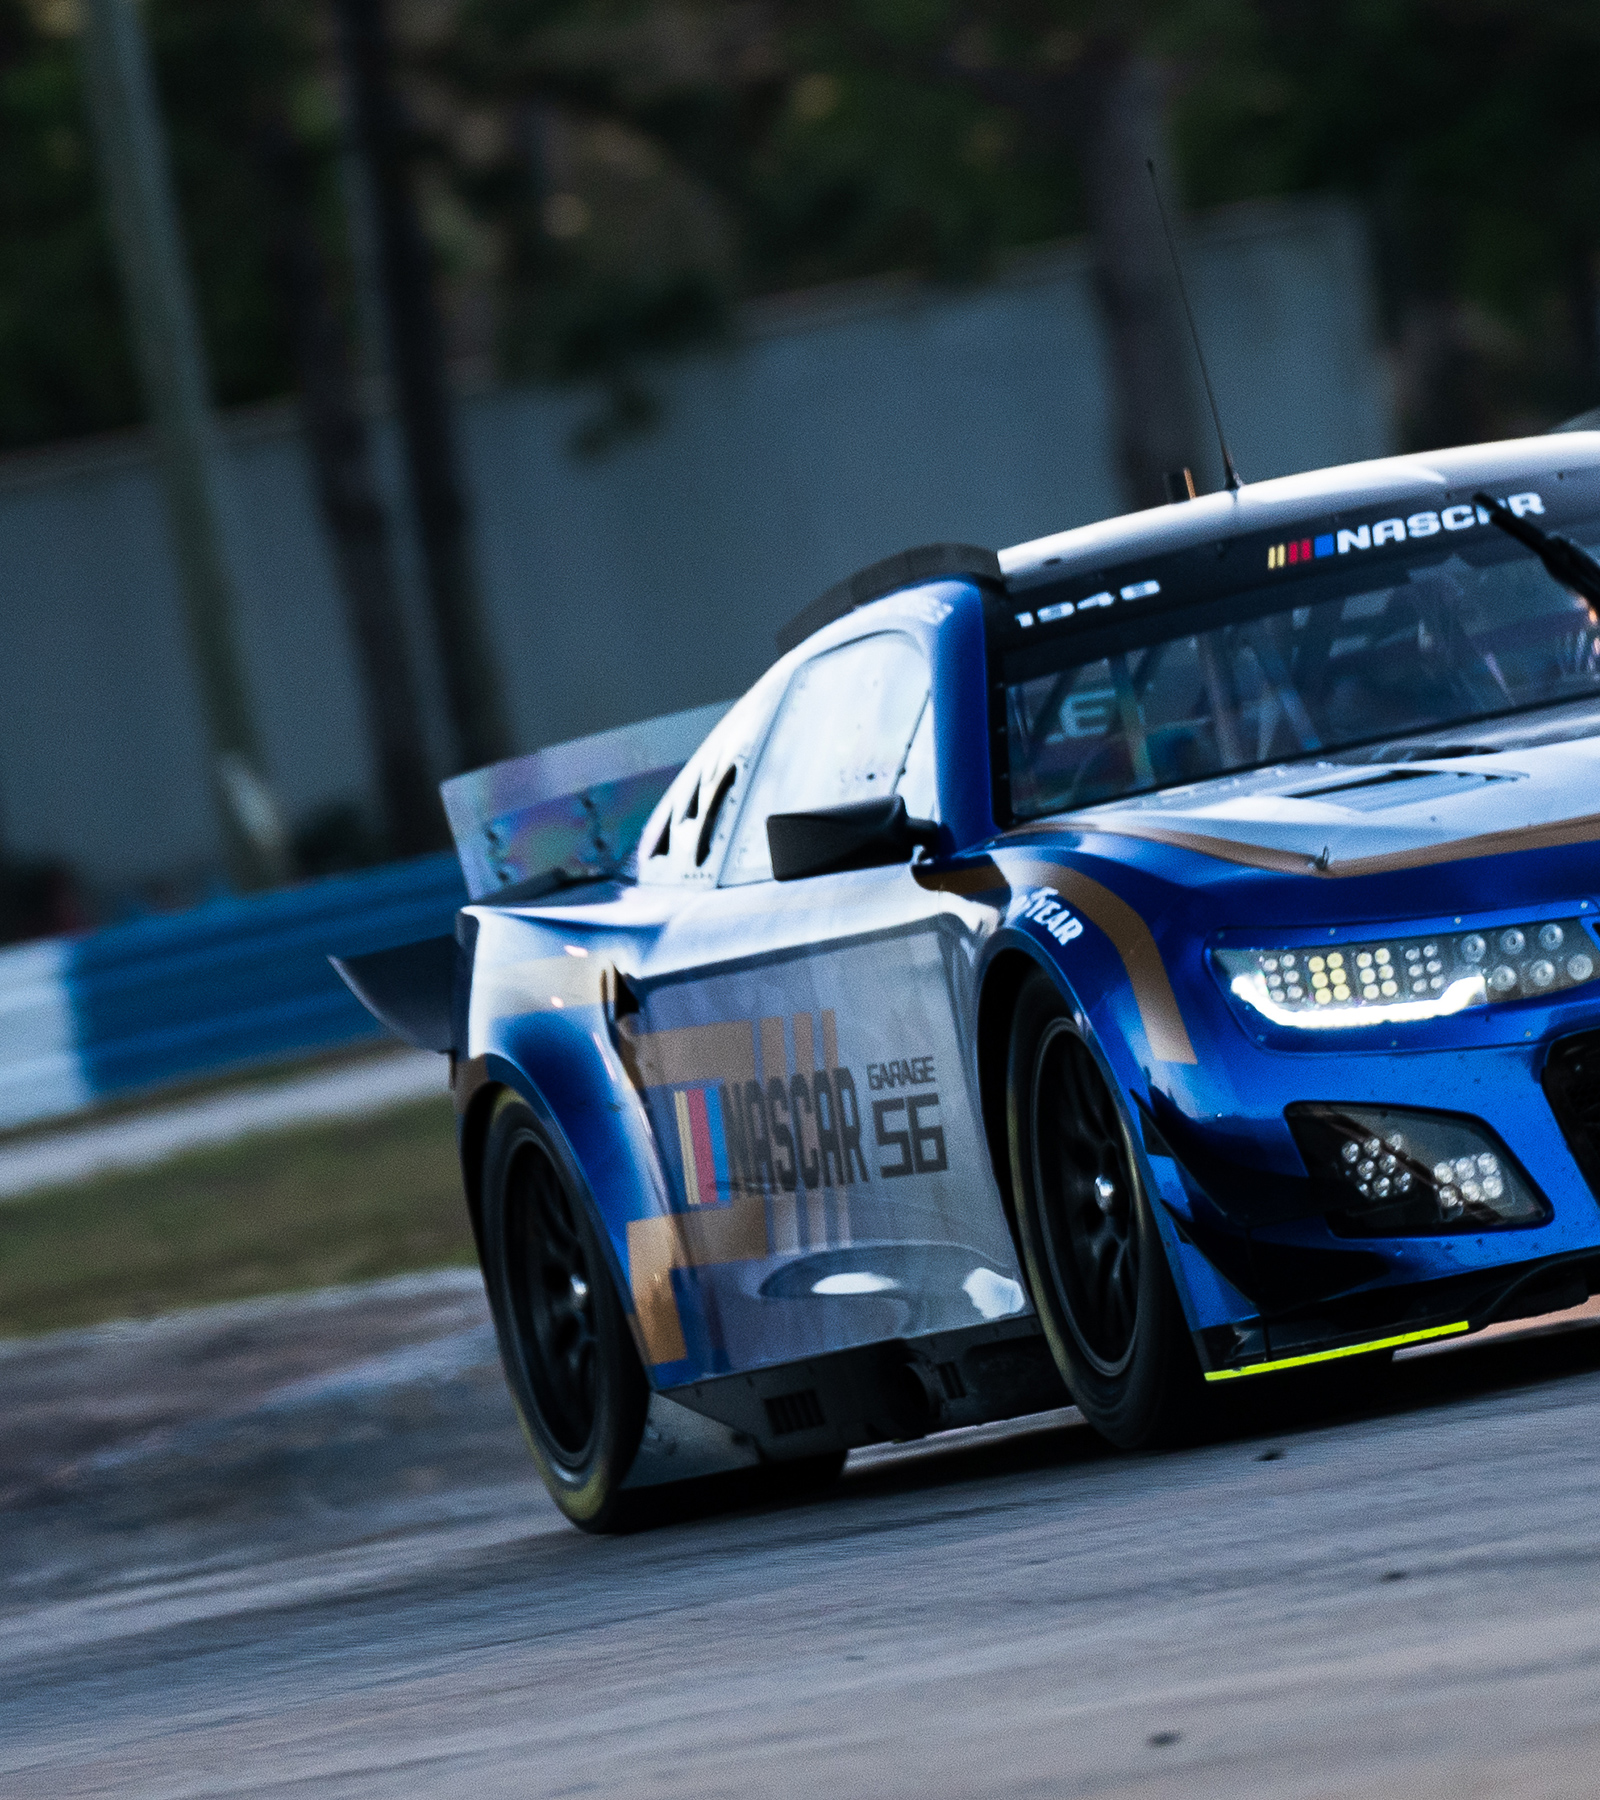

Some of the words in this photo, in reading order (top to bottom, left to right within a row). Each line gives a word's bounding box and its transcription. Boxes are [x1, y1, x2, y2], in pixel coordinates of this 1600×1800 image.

[1010, 887, 1083, 945] YEAR
[867, 1057, 935, 1090] GARAGE
[722, 1067, 867, 1195] NASCAR
[872, 1093, 947, 1178] 56
